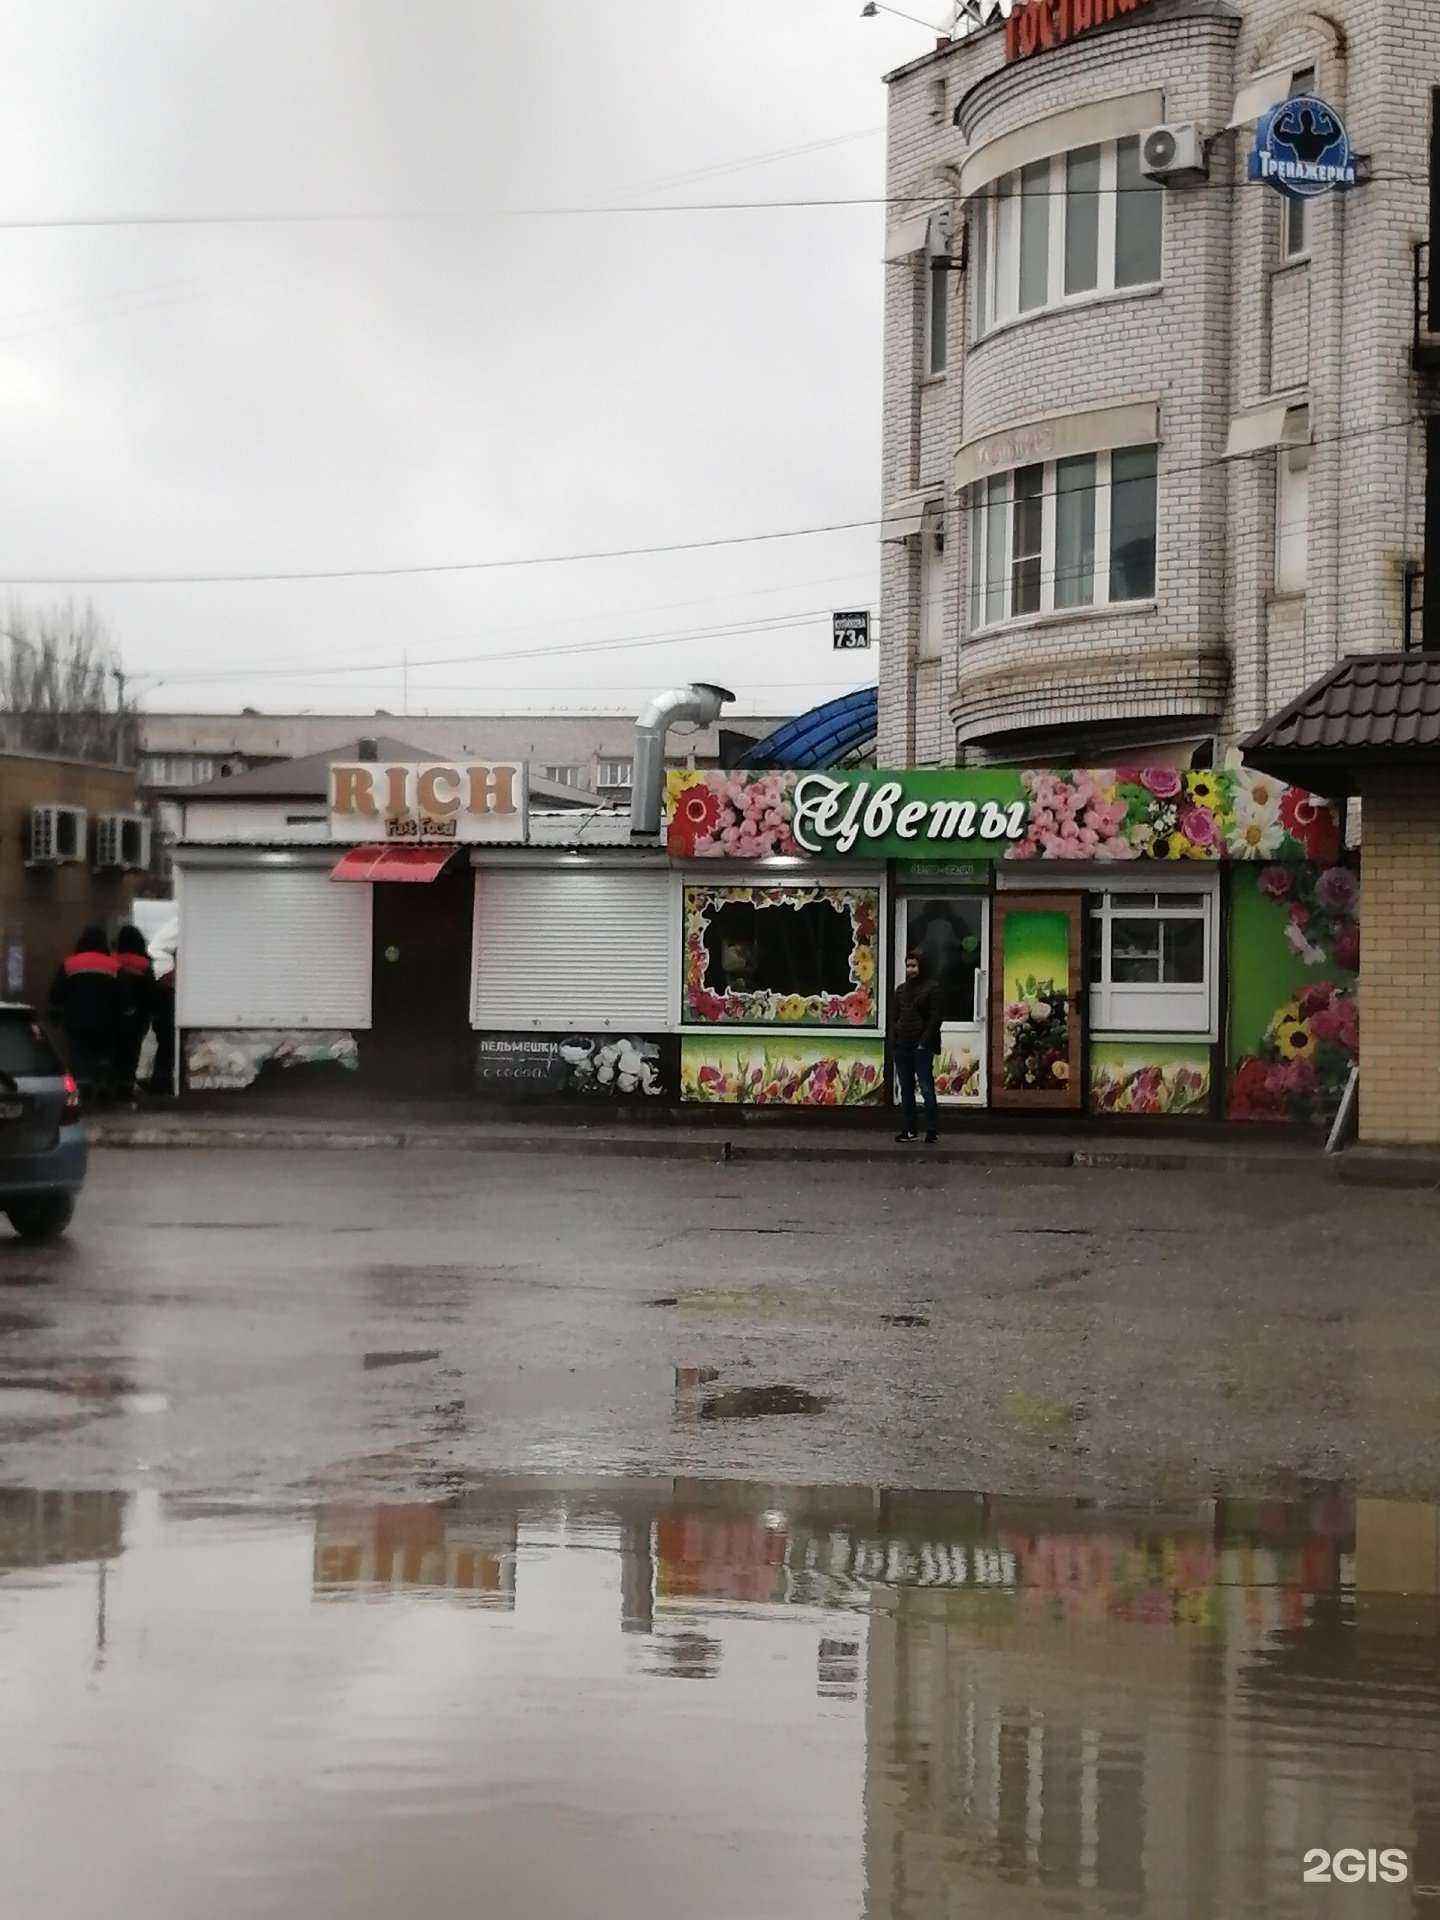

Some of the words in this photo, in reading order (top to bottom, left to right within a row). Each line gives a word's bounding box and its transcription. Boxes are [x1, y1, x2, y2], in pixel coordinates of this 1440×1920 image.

[332, 766, 518, 816] RICH
[793, 774, 1025, 853] Цветы
[481, 1040, 559, 1054] ПЕЛЬМЕШКИ
